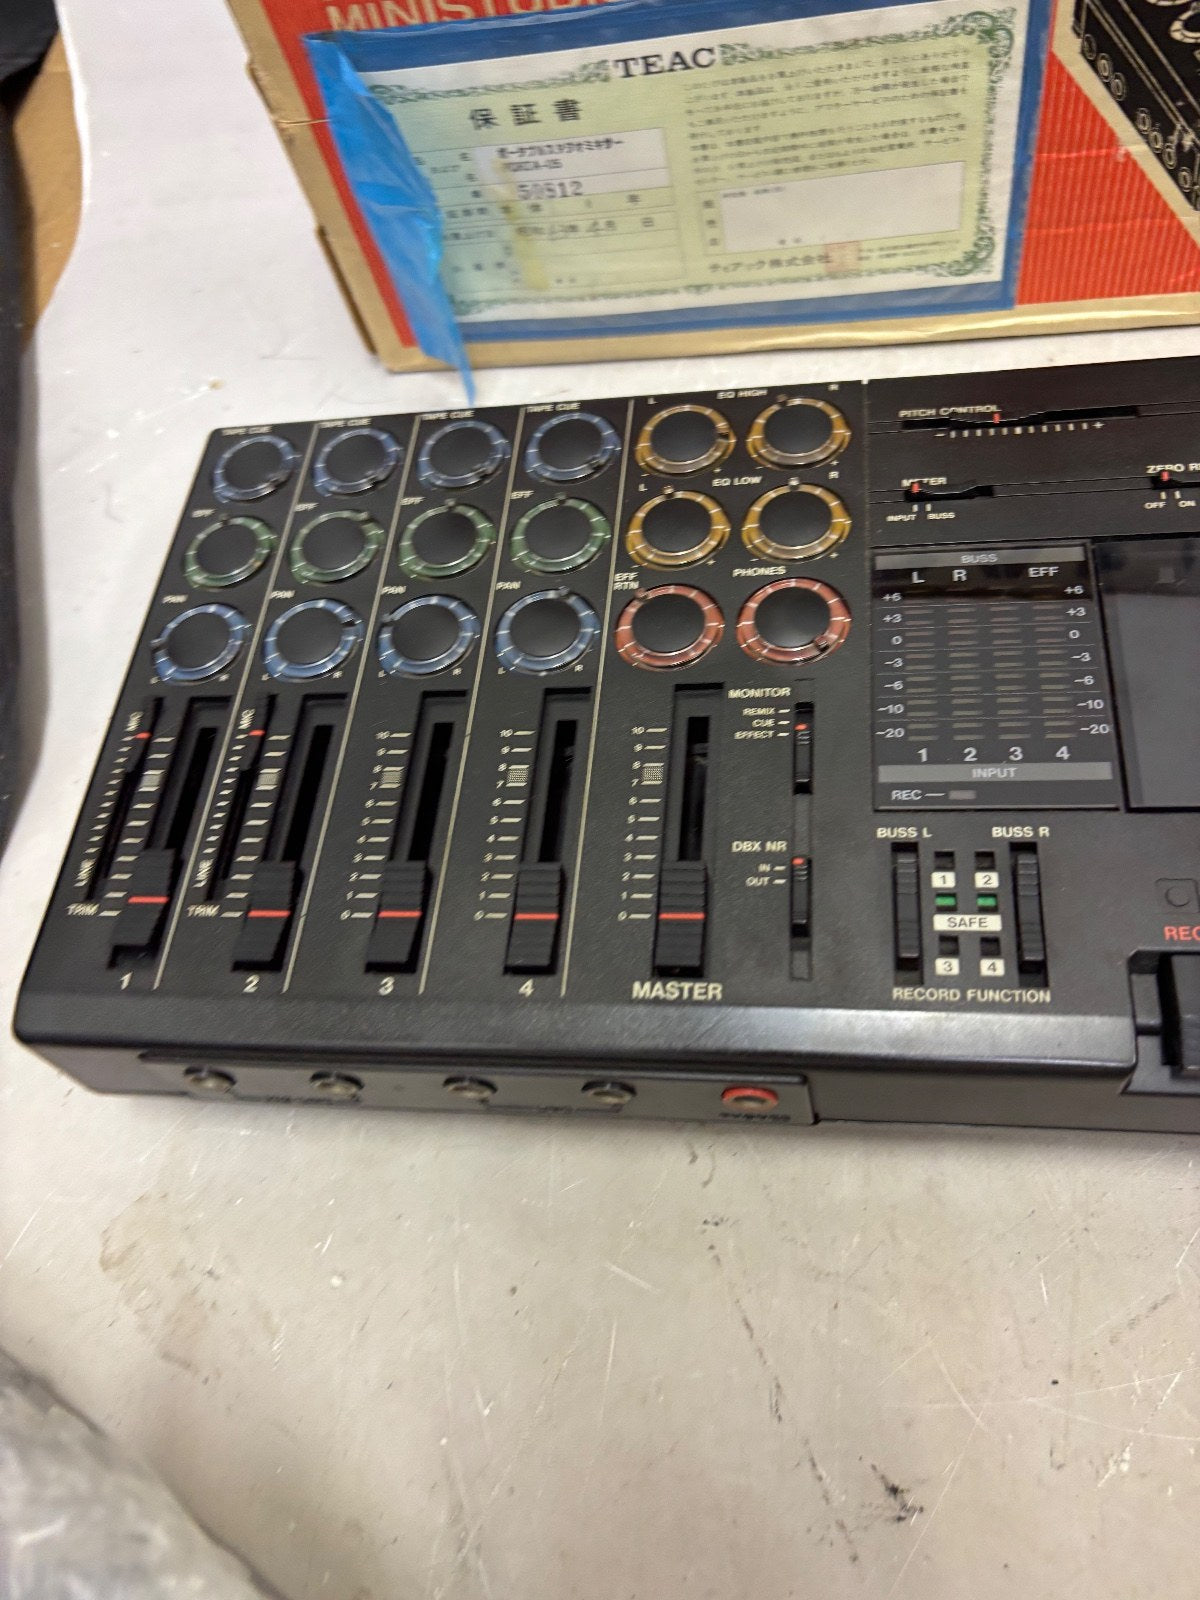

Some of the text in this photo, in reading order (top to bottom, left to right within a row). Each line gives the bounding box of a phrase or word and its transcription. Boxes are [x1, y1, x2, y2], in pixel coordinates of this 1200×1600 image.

[613, 47, 717, 79] TEAC
[468, 98, 582, 130] 保証書
[717, 387, 768, 400] EQ HIGH
[898, 404, 1002, 418] PITCH CONTROL
[712, 475, 763, 488] EQ LOW
[901, 477, 947, 487] MTER
[1144, 500, 1197, 510] OFF ON
[886, 511, 956, 522] INPUT BUSS
[961, 553, 998, 565] BUSS
[614, 572, 638, 582] EFF
[732, 566, 787, 578] PHONES
[912, 566, 1060, 585] L R EFF
[613, 580, 639, 591] RTN
[1064, 585, 1084, 595] +6
[882, 593, 902, 602] +6
[882, 613, 902, 623] +3
[1065, 607, 1086, 617] +3
[1069, 629, 1080, 640] 0
[891, 636, 902, 646] 0
[728, 686, 791, 699] MONITOR
[742, 707, 776, 716] REMIX
[752, 718, 776, 727] CUE
[734, 729, 775, 740] EFFECT
[917, 746, 1071, 762] 1 2 3 4
[972, 767, 1018, 779] INPUT
[891, 789, 922, 801] REC
[876, 827, 933, 839] BUSS L
[991, 826, 1050, 838] BUSS R
[731, 840, 788, 853] DBX NR
[758, 863, 771, 873] IN
[745, 876, 772, 887] OUT
[982, 874, 993, 885] 2
[947, 916, 988, 928] SAFE
[1163, 925, 1200, 942] REC
[943, 961, 954, 973] 3
[986, 961, 997, 973] 4
[120, 970, 133, 990] 1
[242, 974, 261, 993] 2
[378, 976, 395, 996] 3
[518, 978, 535, 998] 4
[632, 980, 722, 1001] MASTER
[892, 987, 1051, 1004] RECORD FUNCTION
